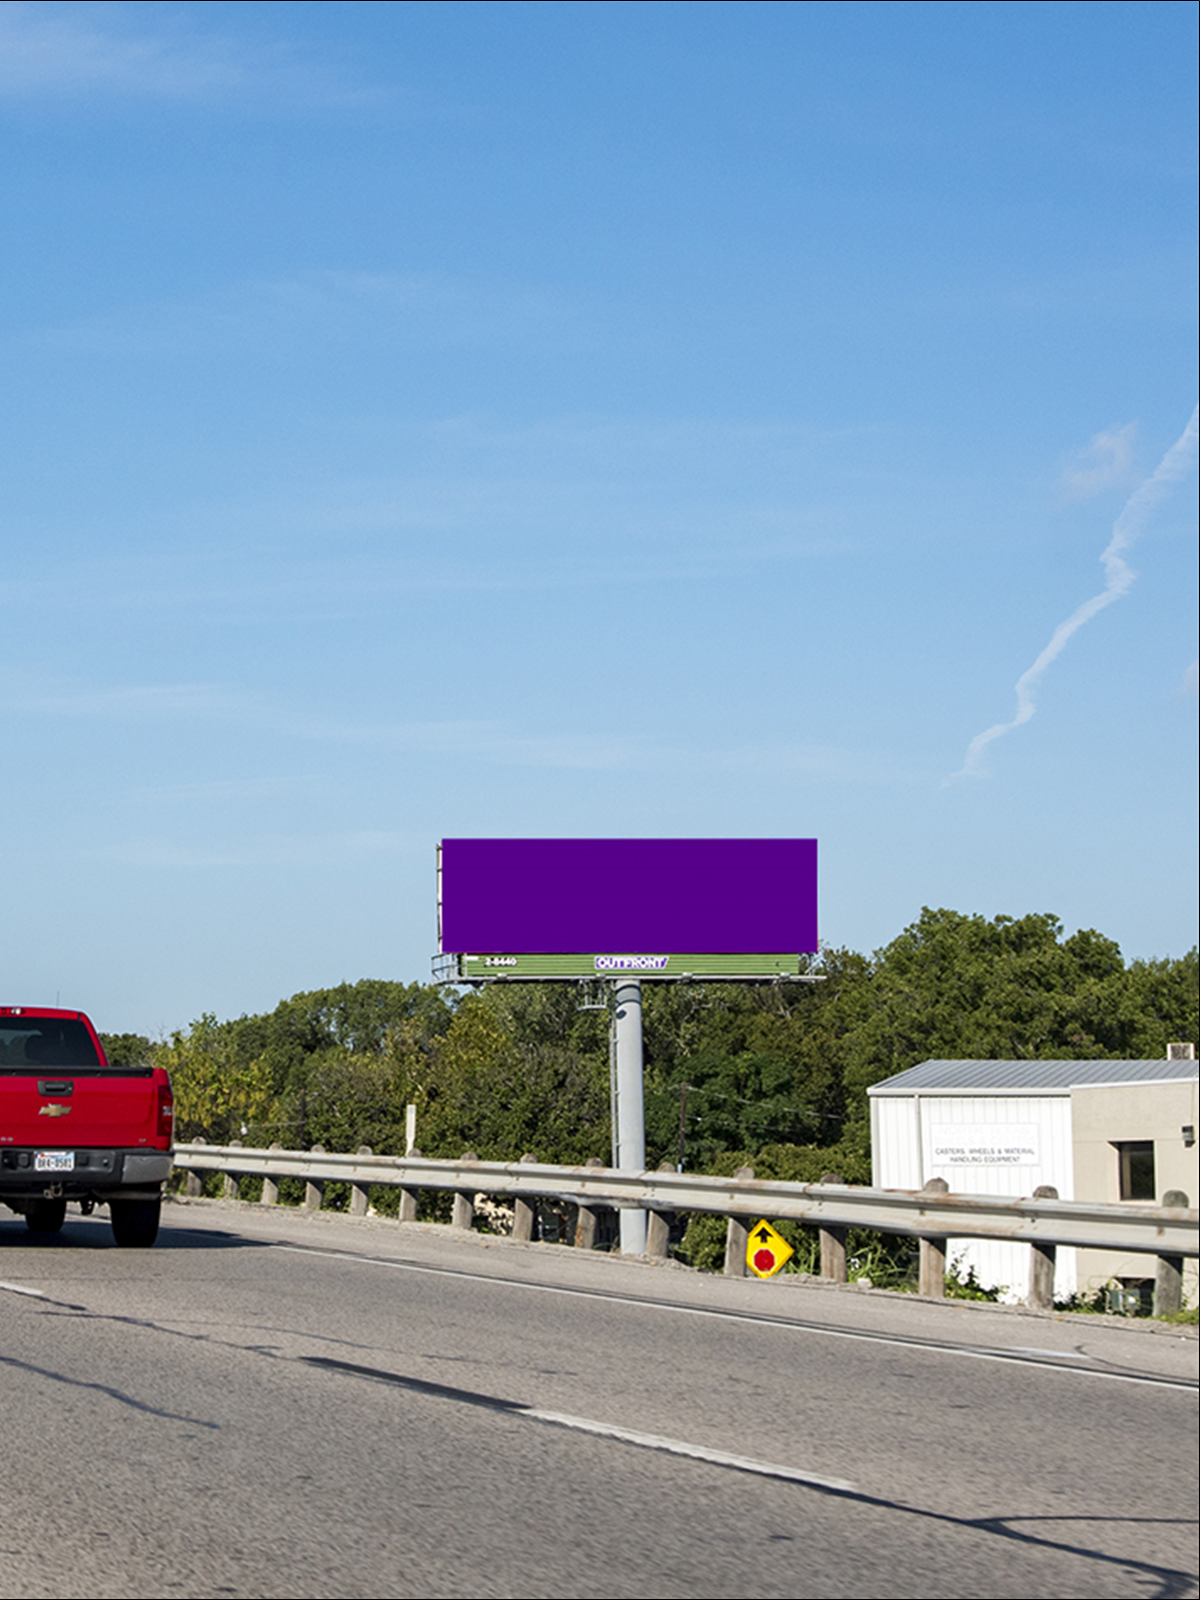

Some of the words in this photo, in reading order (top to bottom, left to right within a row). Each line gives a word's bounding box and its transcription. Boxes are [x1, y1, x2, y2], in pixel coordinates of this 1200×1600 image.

[597, 957, 665, 969] OUTFRONT
[968, 1147, 995, 1155] WHEELS
[1004, 1147, 1036, 1156] MATERIAL
[949, 1155, 982, 1163] HANDLING
[984, 1155, 1021, 1163] EQUIPMENT
